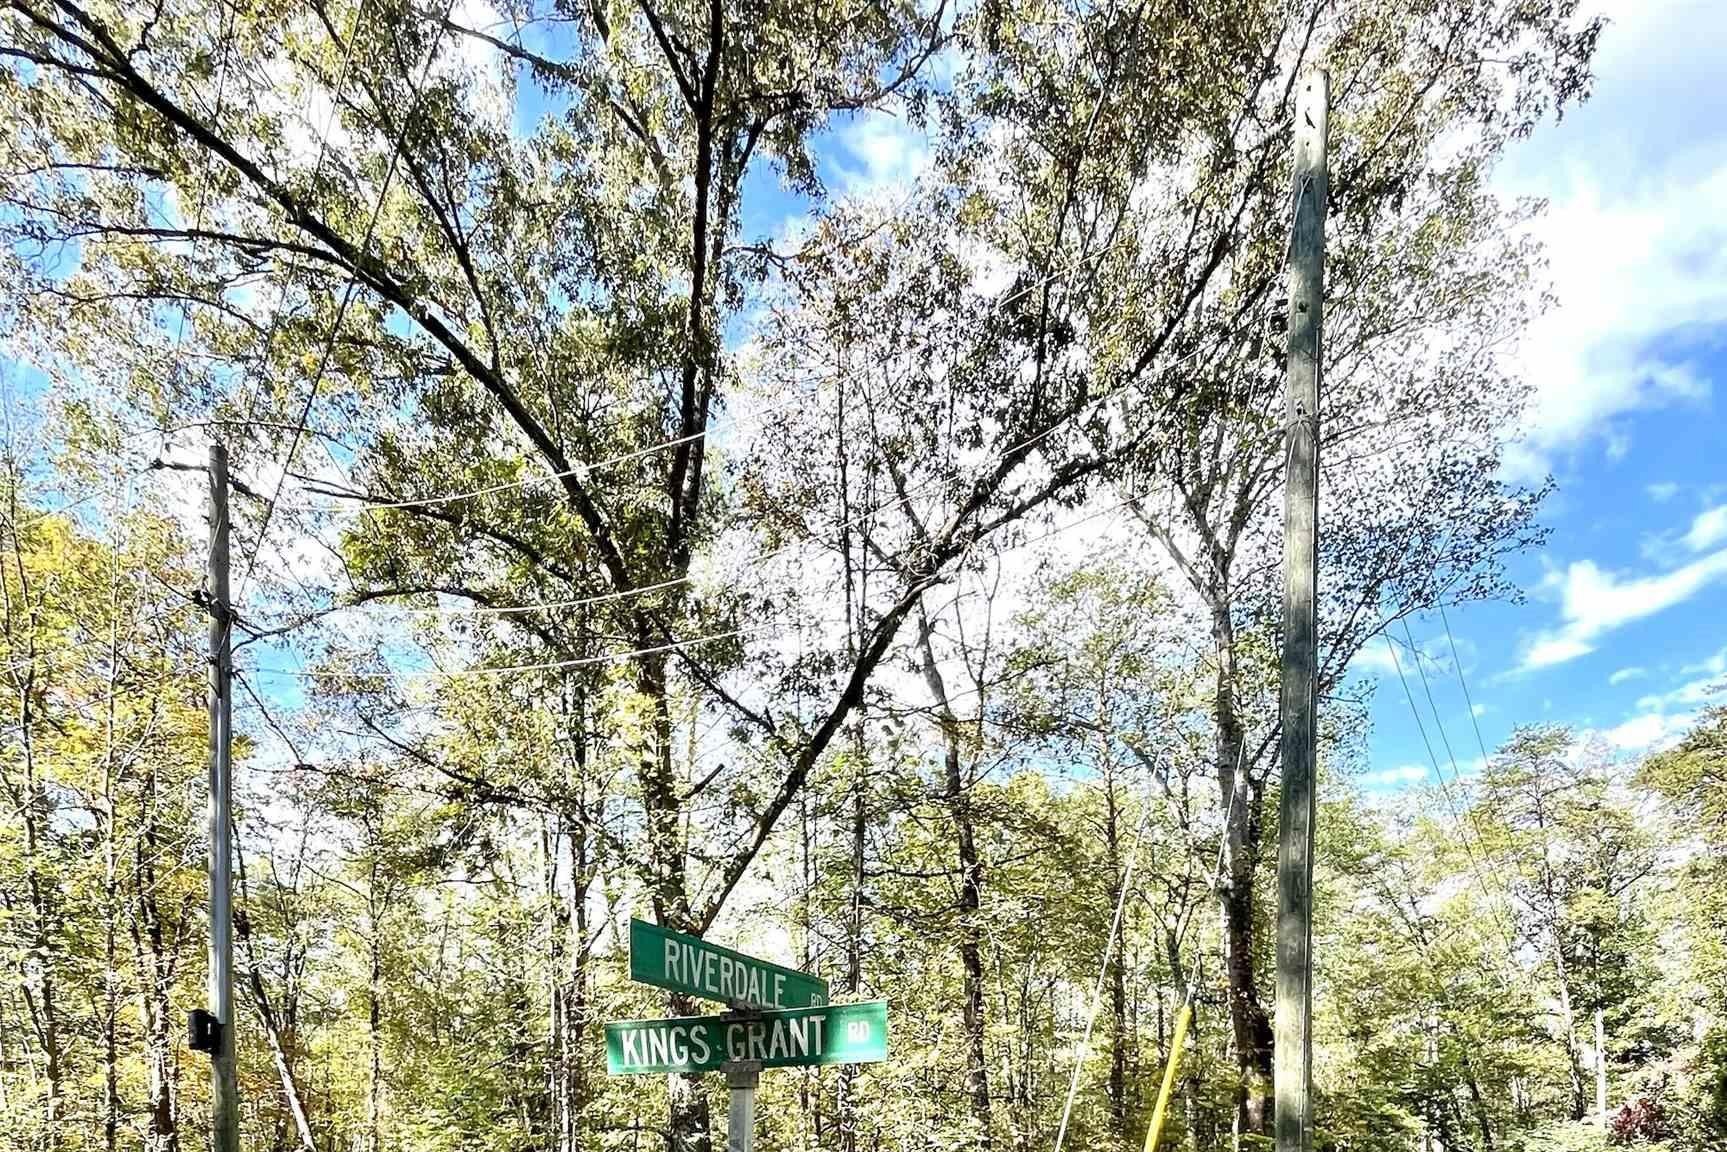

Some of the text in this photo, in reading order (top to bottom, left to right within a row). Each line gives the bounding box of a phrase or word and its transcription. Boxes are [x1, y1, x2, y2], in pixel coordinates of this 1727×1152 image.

[664, 938, 786, 1007] RIVERDALE
[621, 1015, 870, 1066] KINGS GRANT RD
